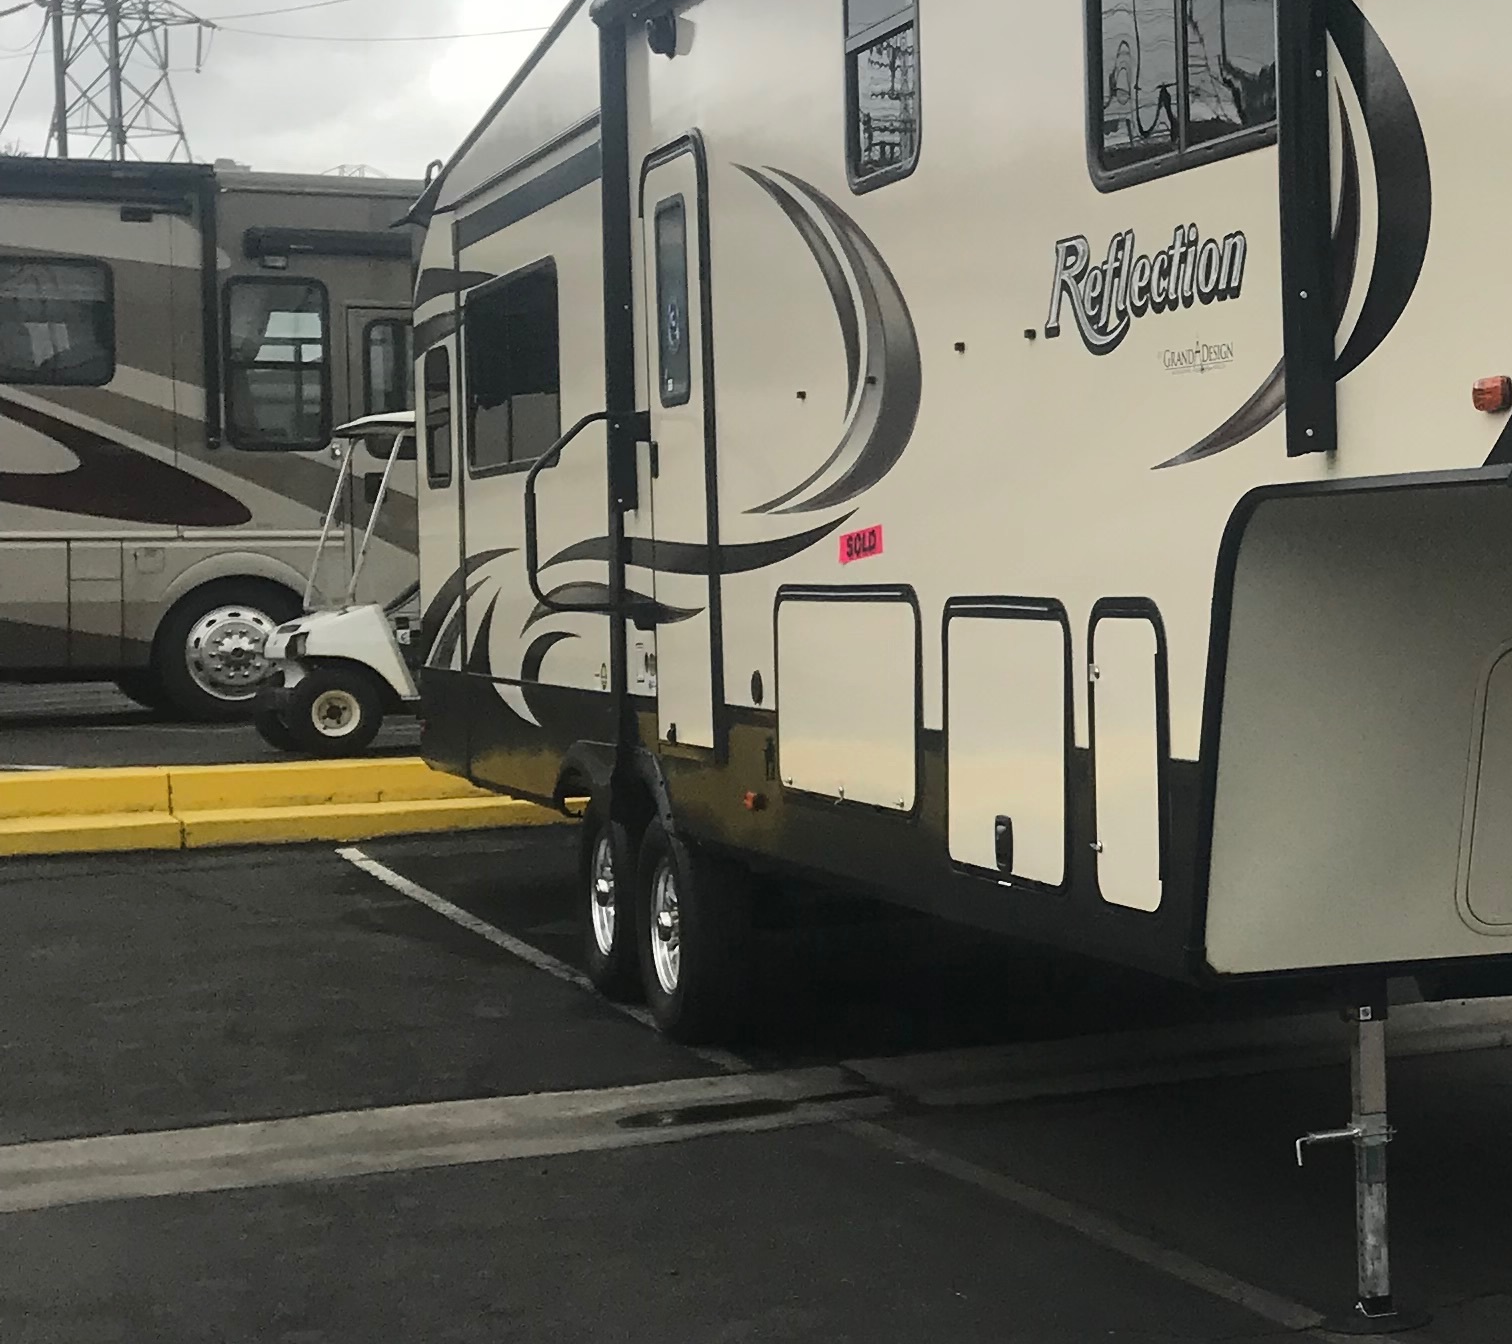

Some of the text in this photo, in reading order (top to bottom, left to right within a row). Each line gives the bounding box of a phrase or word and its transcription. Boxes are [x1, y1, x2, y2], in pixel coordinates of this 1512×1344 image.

[1044, 222, 1248, 357] Reflection
[1163, 348, 1195, 368] GRAND
[1201, 341, 1234, 363] DESIGN
[846, 529, 877, 558] SOLD
